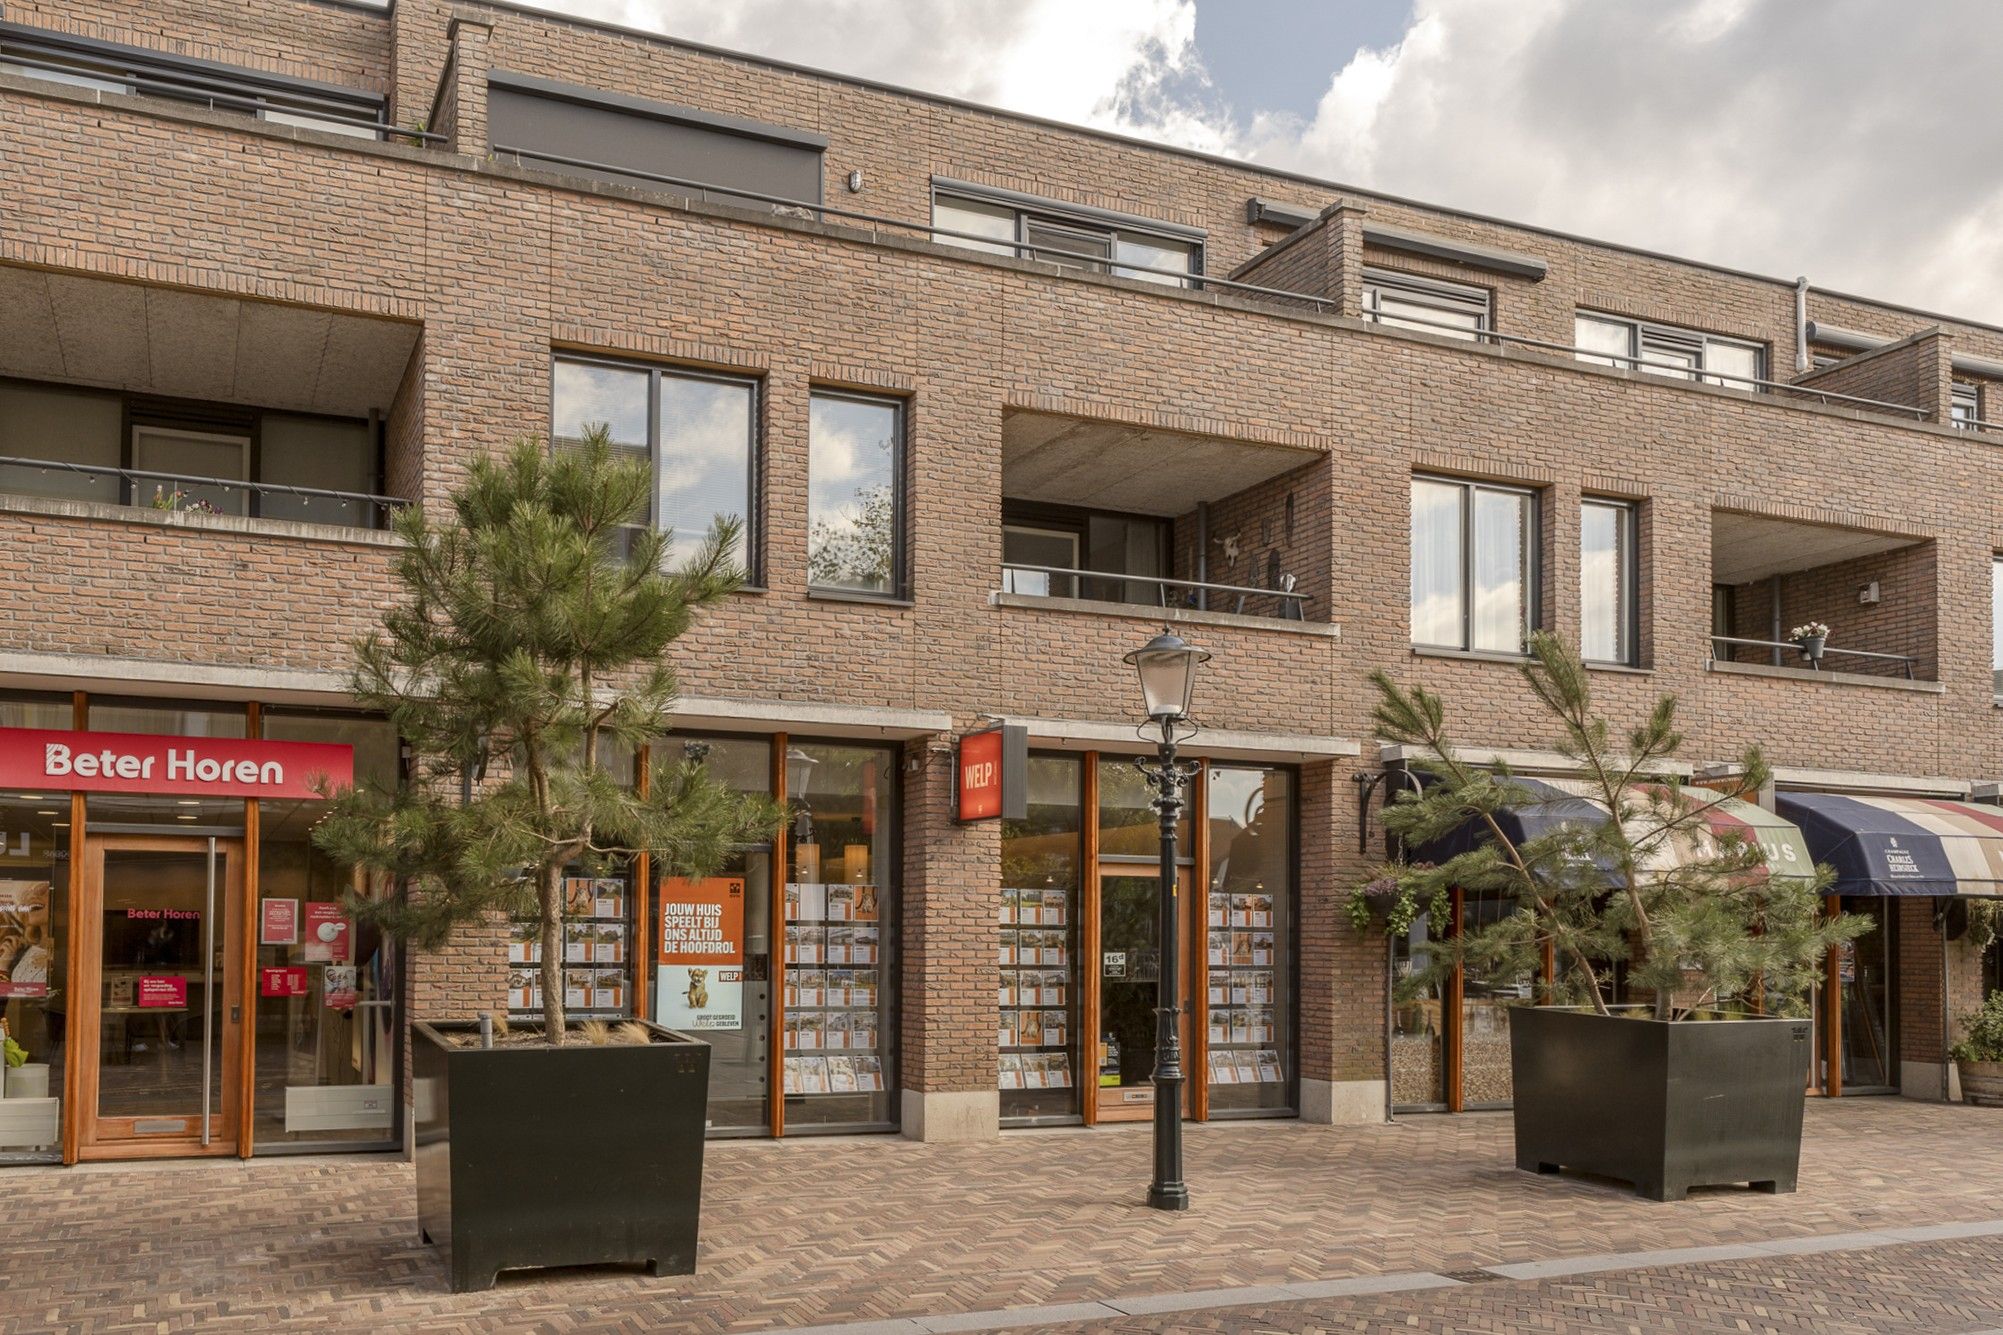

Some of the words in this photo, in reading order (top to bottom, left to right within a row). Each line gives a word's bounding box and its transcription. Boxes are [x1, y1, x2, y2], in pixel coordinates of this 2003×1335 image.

[45, 743, 155, 779] Beter
[167, 748, 284, 784] Horen
[965, 761, 993, 790] WELP
[127, 907, 160, 919] Beter
[163, 908, 200, 920] Horen
[664, 902, 695, 916] JOUW
[696, 903, 722, 916] HUIS
[664, 915, 702, 928] SPEELT
[703, 916, 720, 929] BIJ
[664, 928, 688, 941] ONS
[688, 929, 723, 941] ALTIJD
[664, 940, 679, 954] DE
[680, 941, 736, 954] HOOFDROL
[720, 971, 739, 981] WELP
